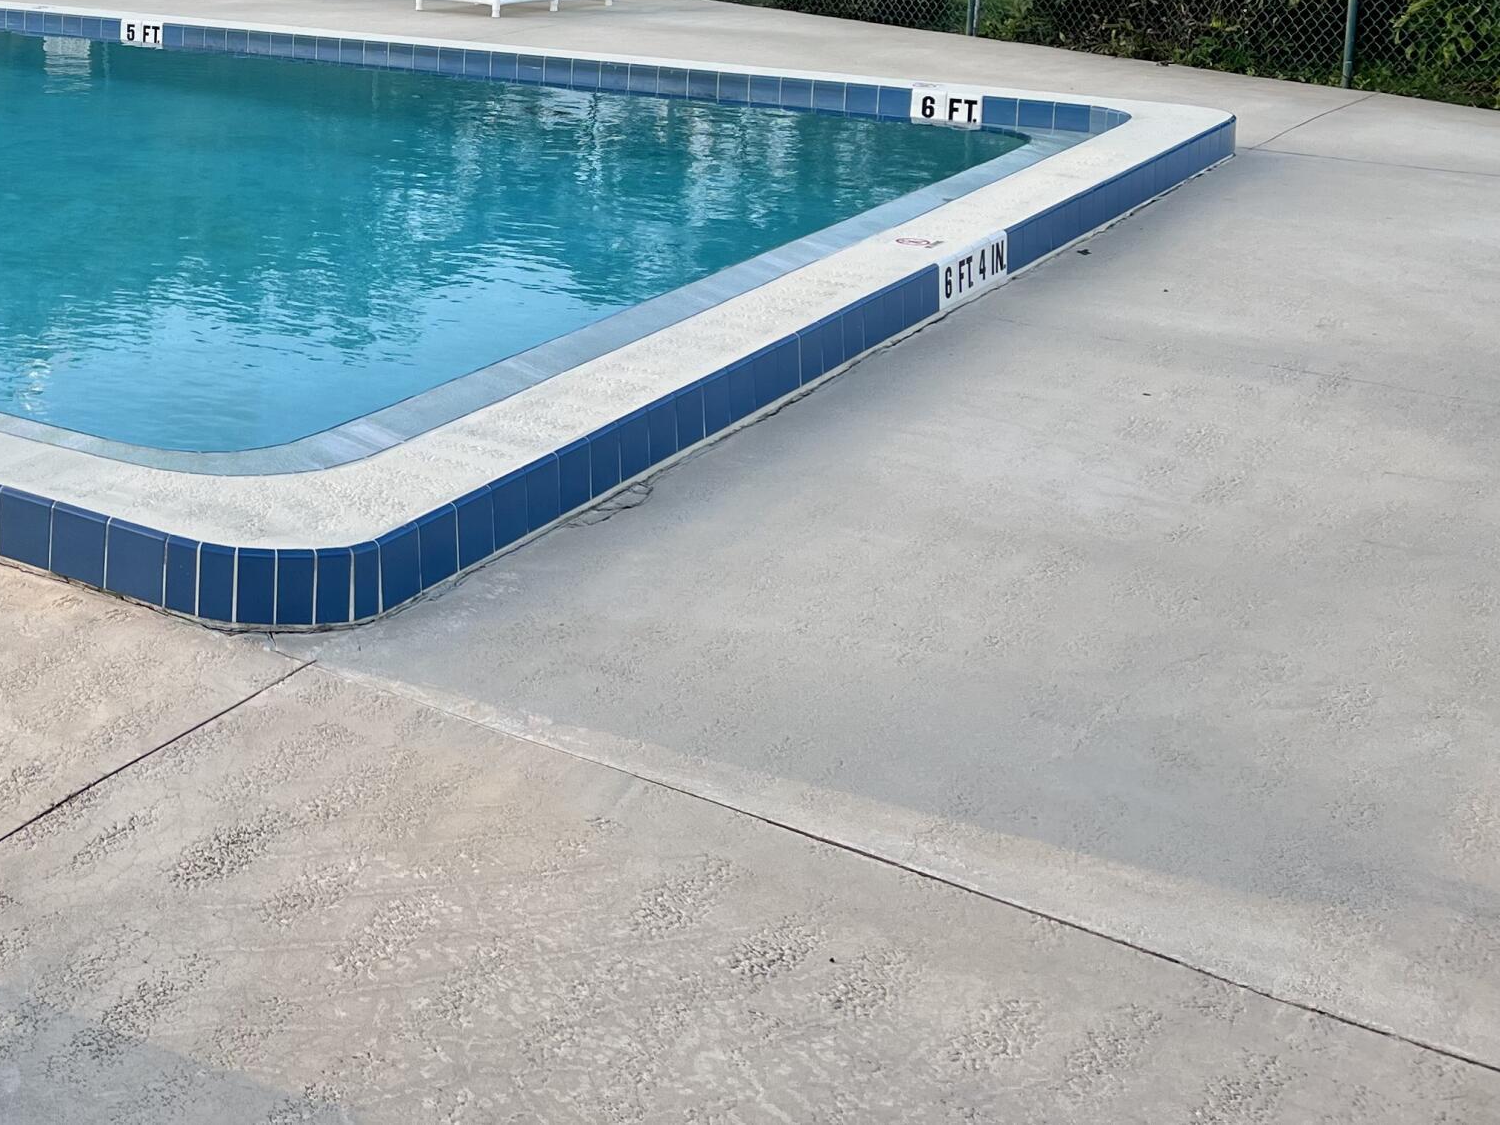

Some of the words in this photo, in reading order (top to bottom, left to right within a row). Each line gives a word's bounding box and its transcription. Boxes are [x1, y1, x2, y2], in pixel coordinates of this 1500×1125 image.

[127, 24, 135, 41] 5
[143, 25, 160, 44] FT.
[921, 96, 935, 118] 6
[948, 98, 978, 123] FT.
[945, 266, 953, 299] 6
[958, 255, 974, 293] FT.
[979, 249, 986, 280] 4
[992, 240, 1006, 275] IN.
